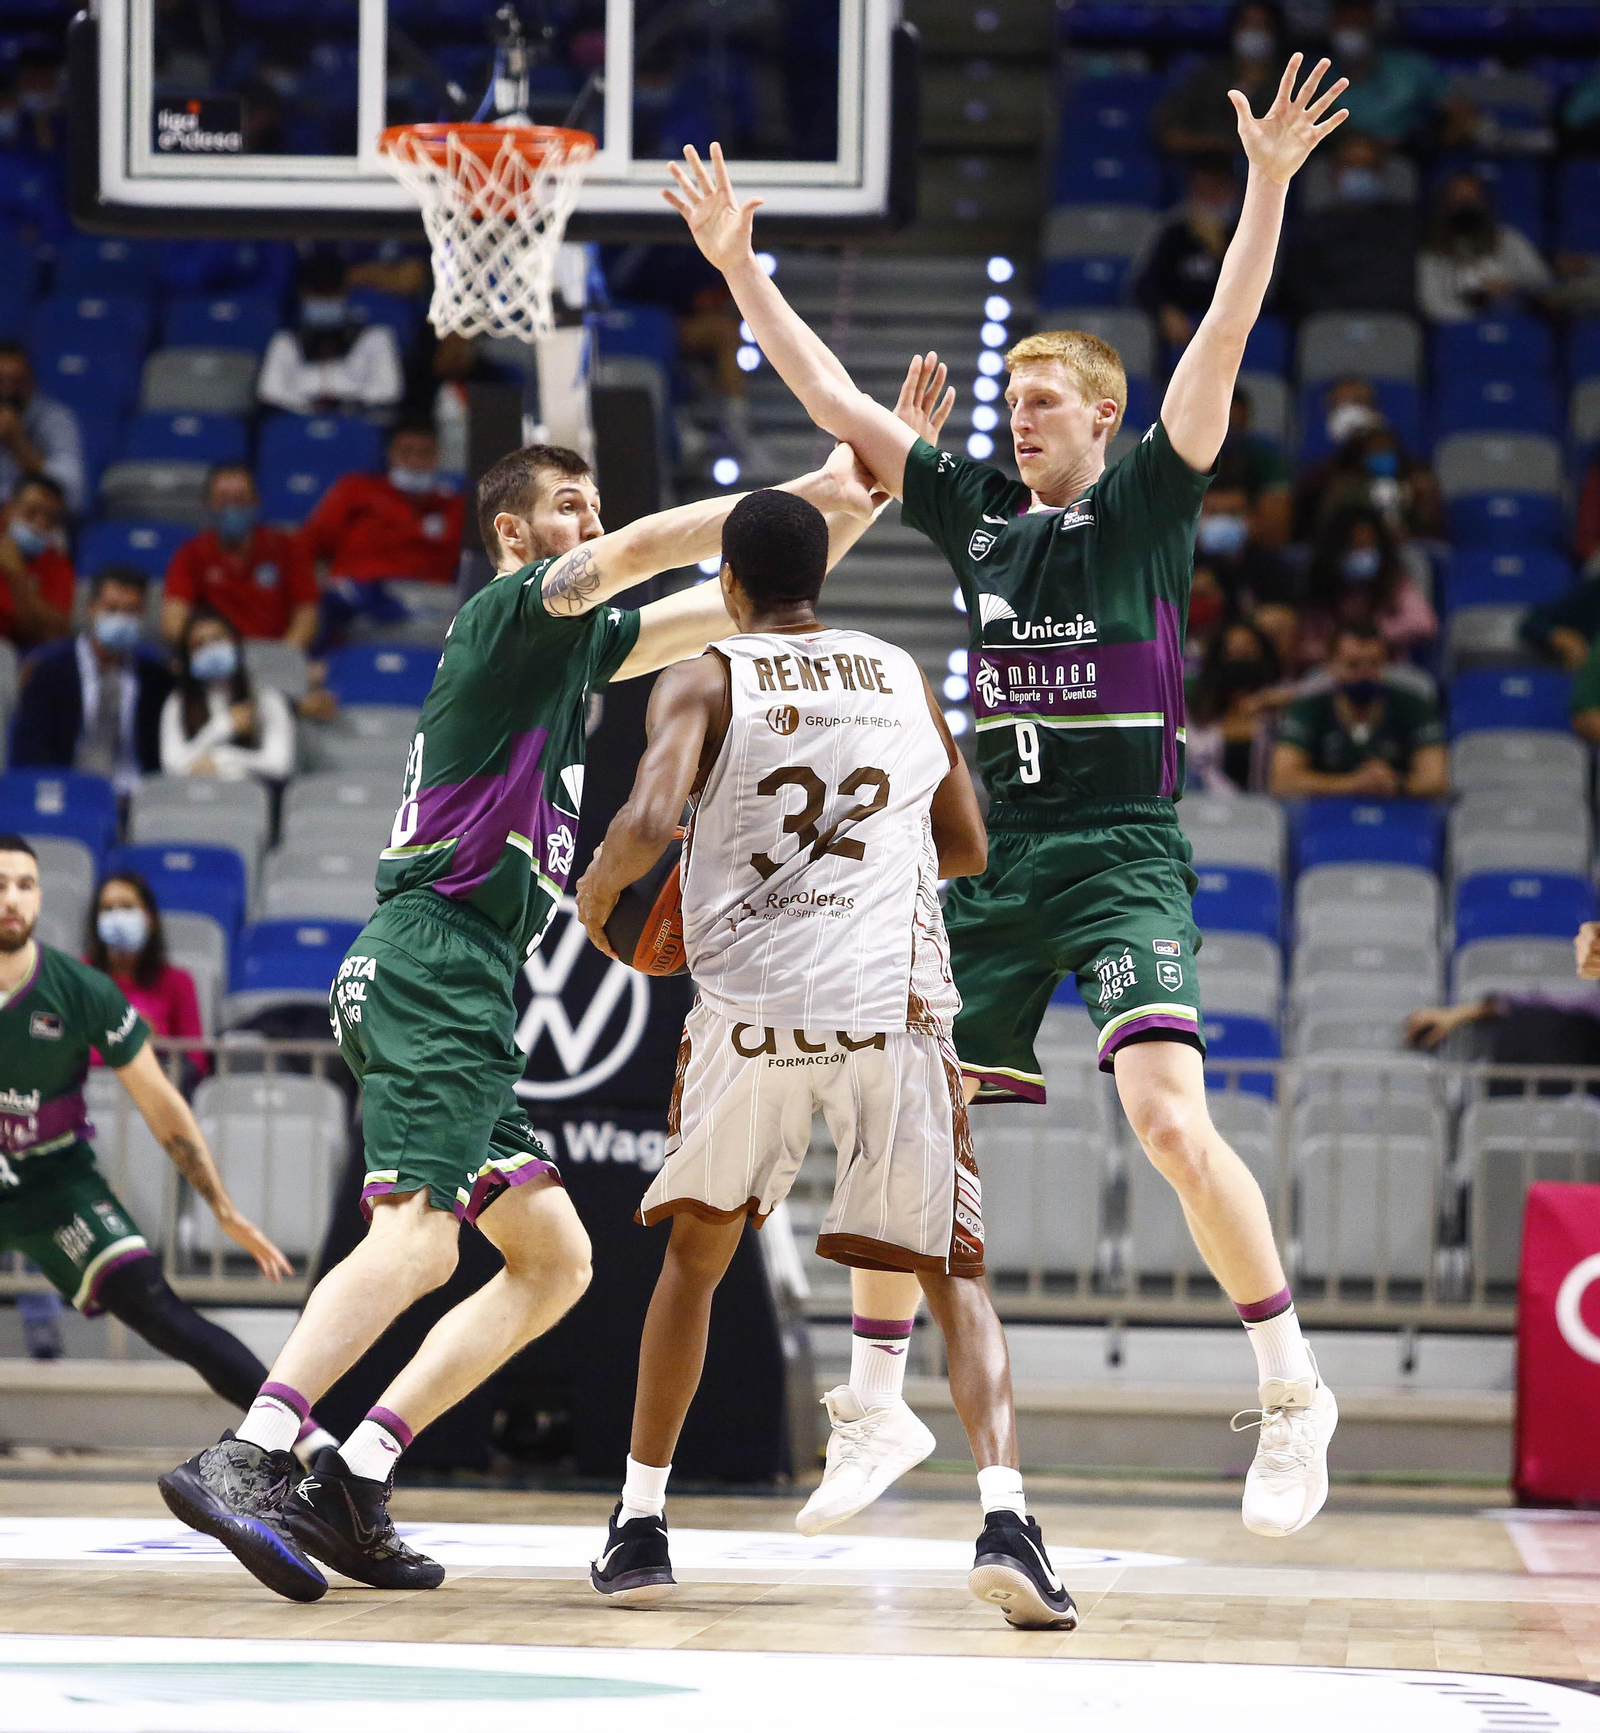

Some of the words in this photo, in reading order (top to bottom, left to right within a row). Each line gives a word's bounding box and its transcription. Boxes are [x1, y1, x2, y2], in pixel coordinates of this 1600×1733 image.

[1012, 613, 1097, 640] Unicaja
[753, 654, 894, 694] RENFROE
[1008, 662, 1097, 686] MÁLAGA
[1009, 690, 1041, 705] Deporte
[1048, 691, 1054, 704] y
[1063, 687, 1097, 701] Eventos
[805, 715, 852, 728] GRUPO
[854, 715, 903, 728] HEREDA
[1015, 722, 1041, 784] 9
[750, 766, 891, 881] 32
[765, 888, 855, 911] Recoletas
[653, 918, 672, 954] LEGACY
[768, 1052, 848, 1068] FORMACIÓN
